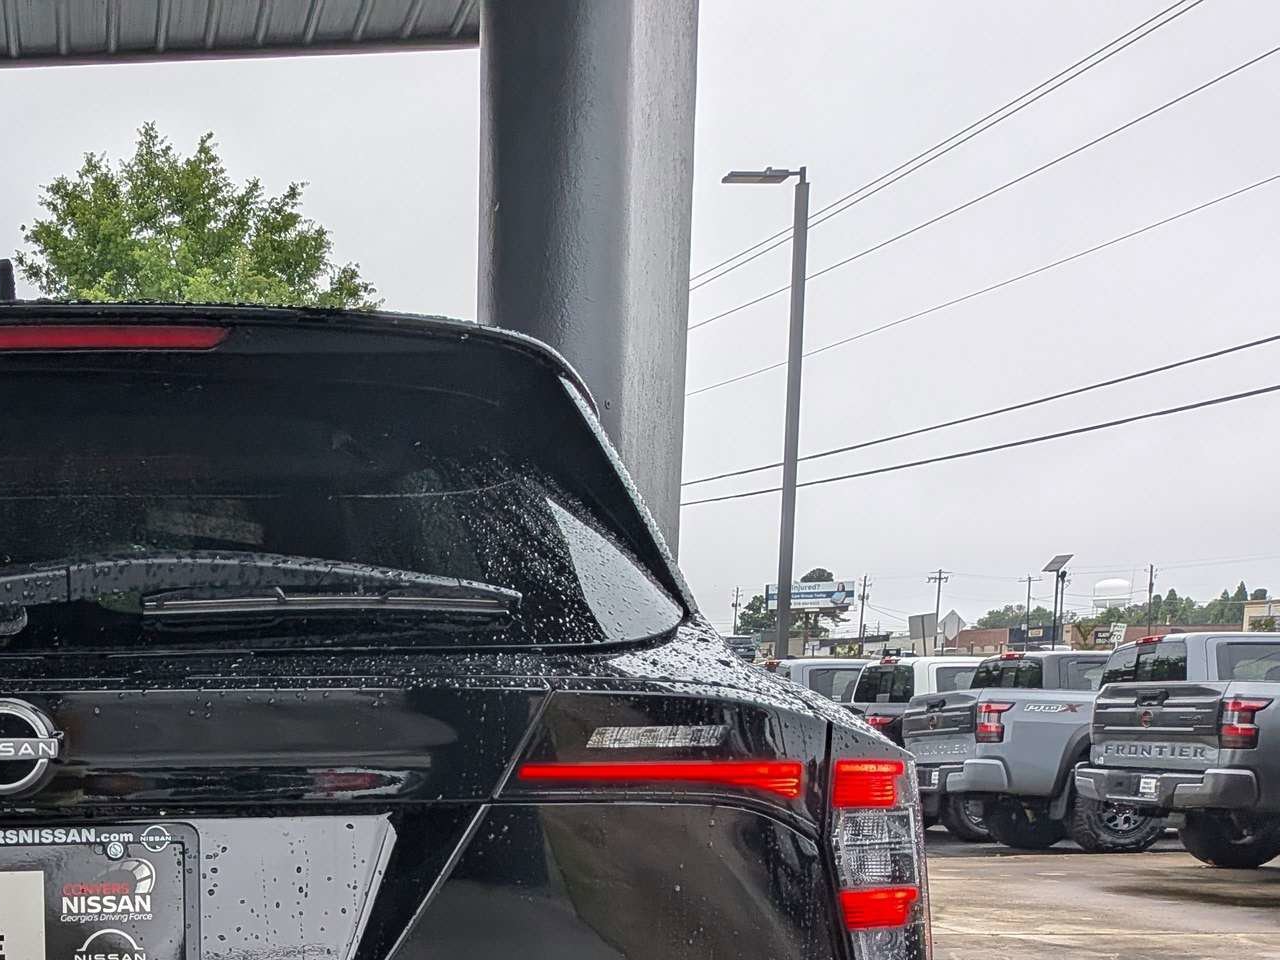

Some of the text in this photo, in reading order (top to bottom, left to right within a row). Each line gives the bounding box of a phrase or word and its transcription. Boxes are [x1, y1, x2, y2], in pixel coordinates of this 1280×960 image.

[1104, 743, 1206, 760] FRONTIER
[140, 834, 173, 843] NISSAN
[61, 895, 152, 914] NISSAN
[99, 913, 128, 923] Driving
[129, 912, 153, 921] Force
